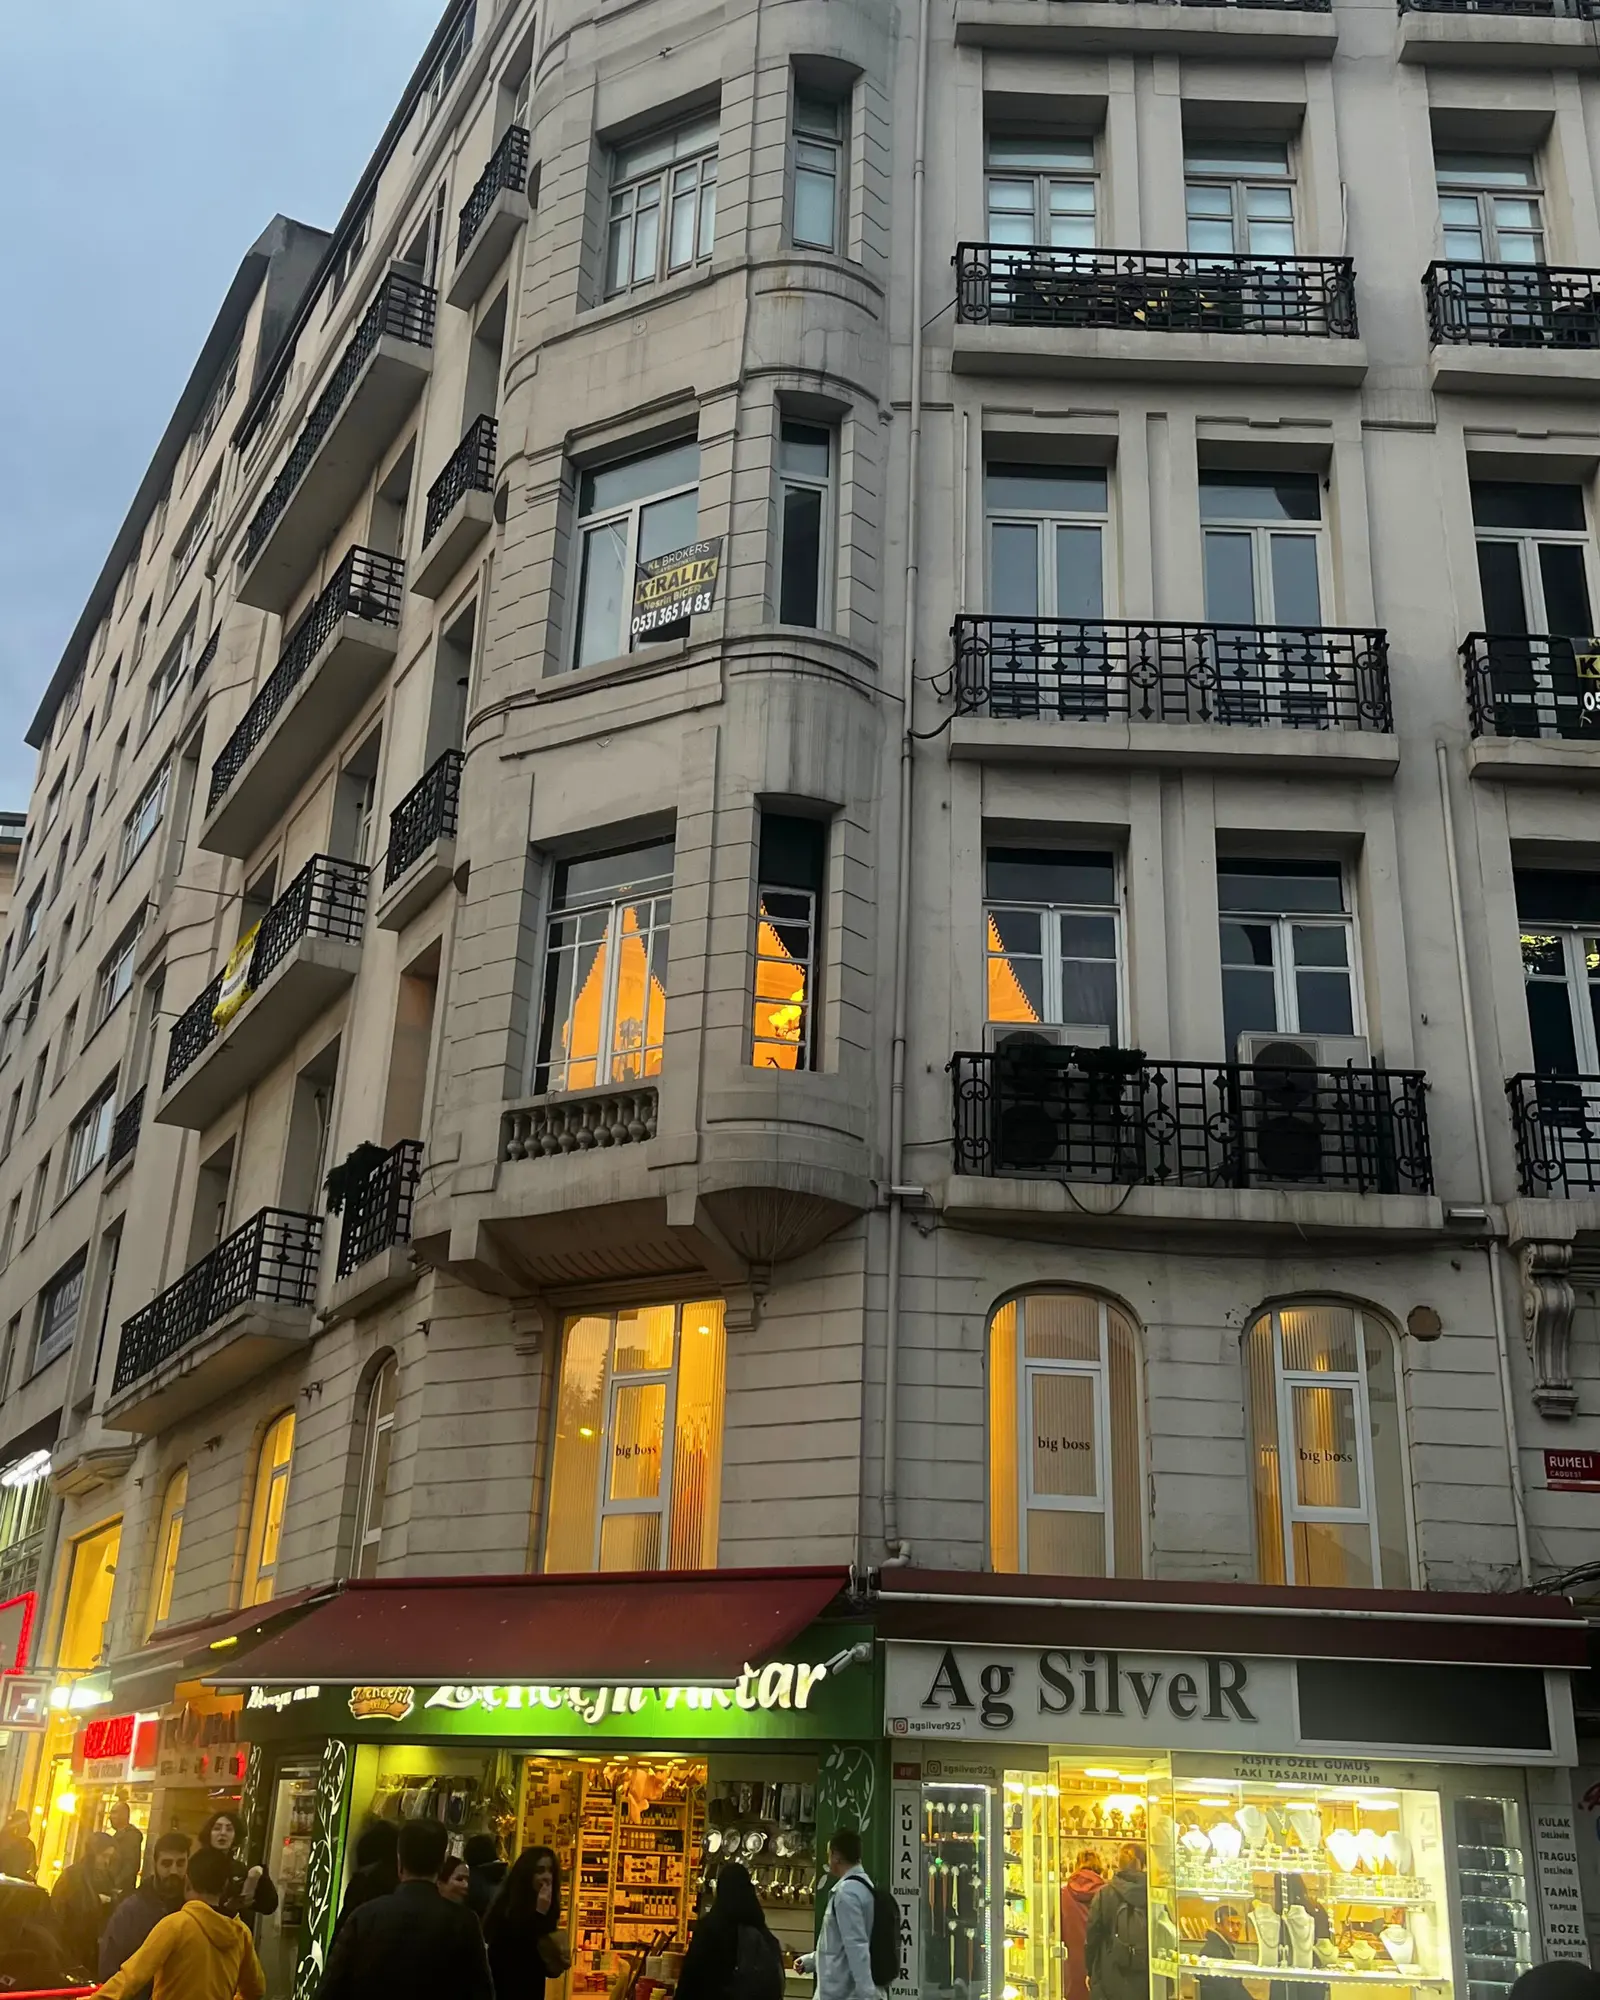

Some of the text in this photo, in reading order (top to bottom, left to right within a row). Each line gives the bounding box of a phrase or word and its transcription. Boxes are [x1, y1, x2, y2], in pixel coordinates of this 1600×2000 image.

[662, 542, 710, 567] BROKERS
[632, 591, 711, 635] 0531 365 14 83
[1038, 1436, 1091, 1452] big boss
[616, 1443, 657, 1459] big boss
[1299, 1448, 1353, 1464] big boss
[921, 1648, 1016, 1730] Ag
[910, 1721, 961, 1731] agsilver925
[1334, 1772, 1380, 1785] YAPILIR
[1538, 1817, 1571, 1828] KULAK
[901, 1804, 912, 1880] KULAK
[1539, 1851, 1577, 1862] TRAGUS
[1549, 1903, 1578, 1911] YAPILIR
[1550, 1923, 1580, 1934] ROZE
[1547, 1938, 1587, 1946] KAPLAMA
[892, 1987, 918, 1996] YAPILIR
